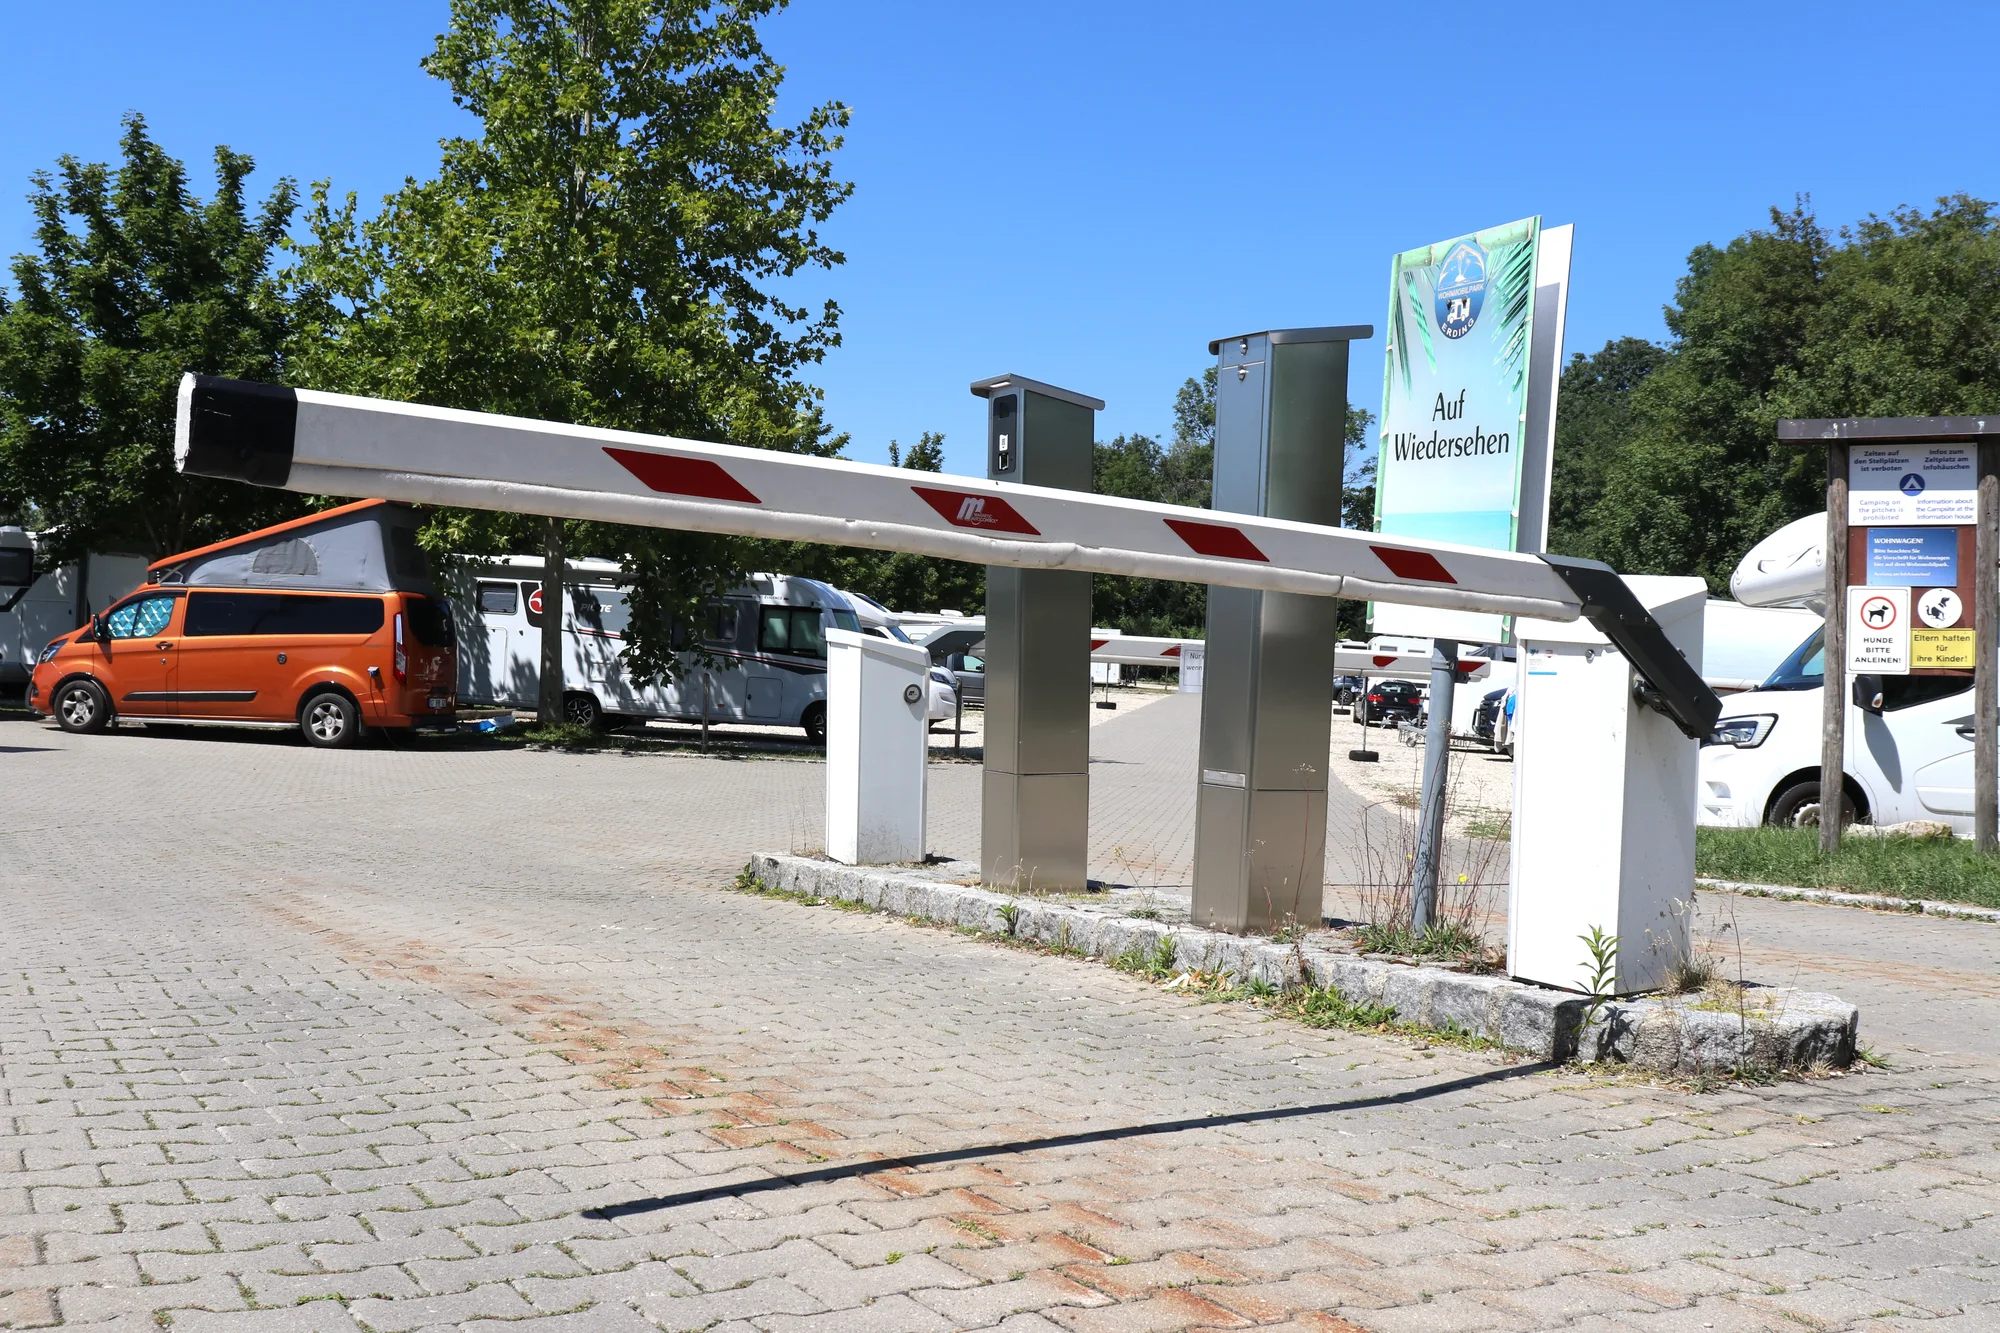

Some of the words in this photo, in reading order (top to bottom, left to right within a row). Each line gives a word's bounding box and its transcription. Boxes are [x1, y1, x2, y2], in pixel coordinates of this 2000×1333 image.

[1438, 284, 1484, 300] WOHNMOBILPARK
[1442, 318, 1474, 338] ERDING
[1432, 389, 1466, 422] Auf
[1394, 424, 1510, 462] Wiedersehen
[1914, 634, 1939, 642] Eltern
